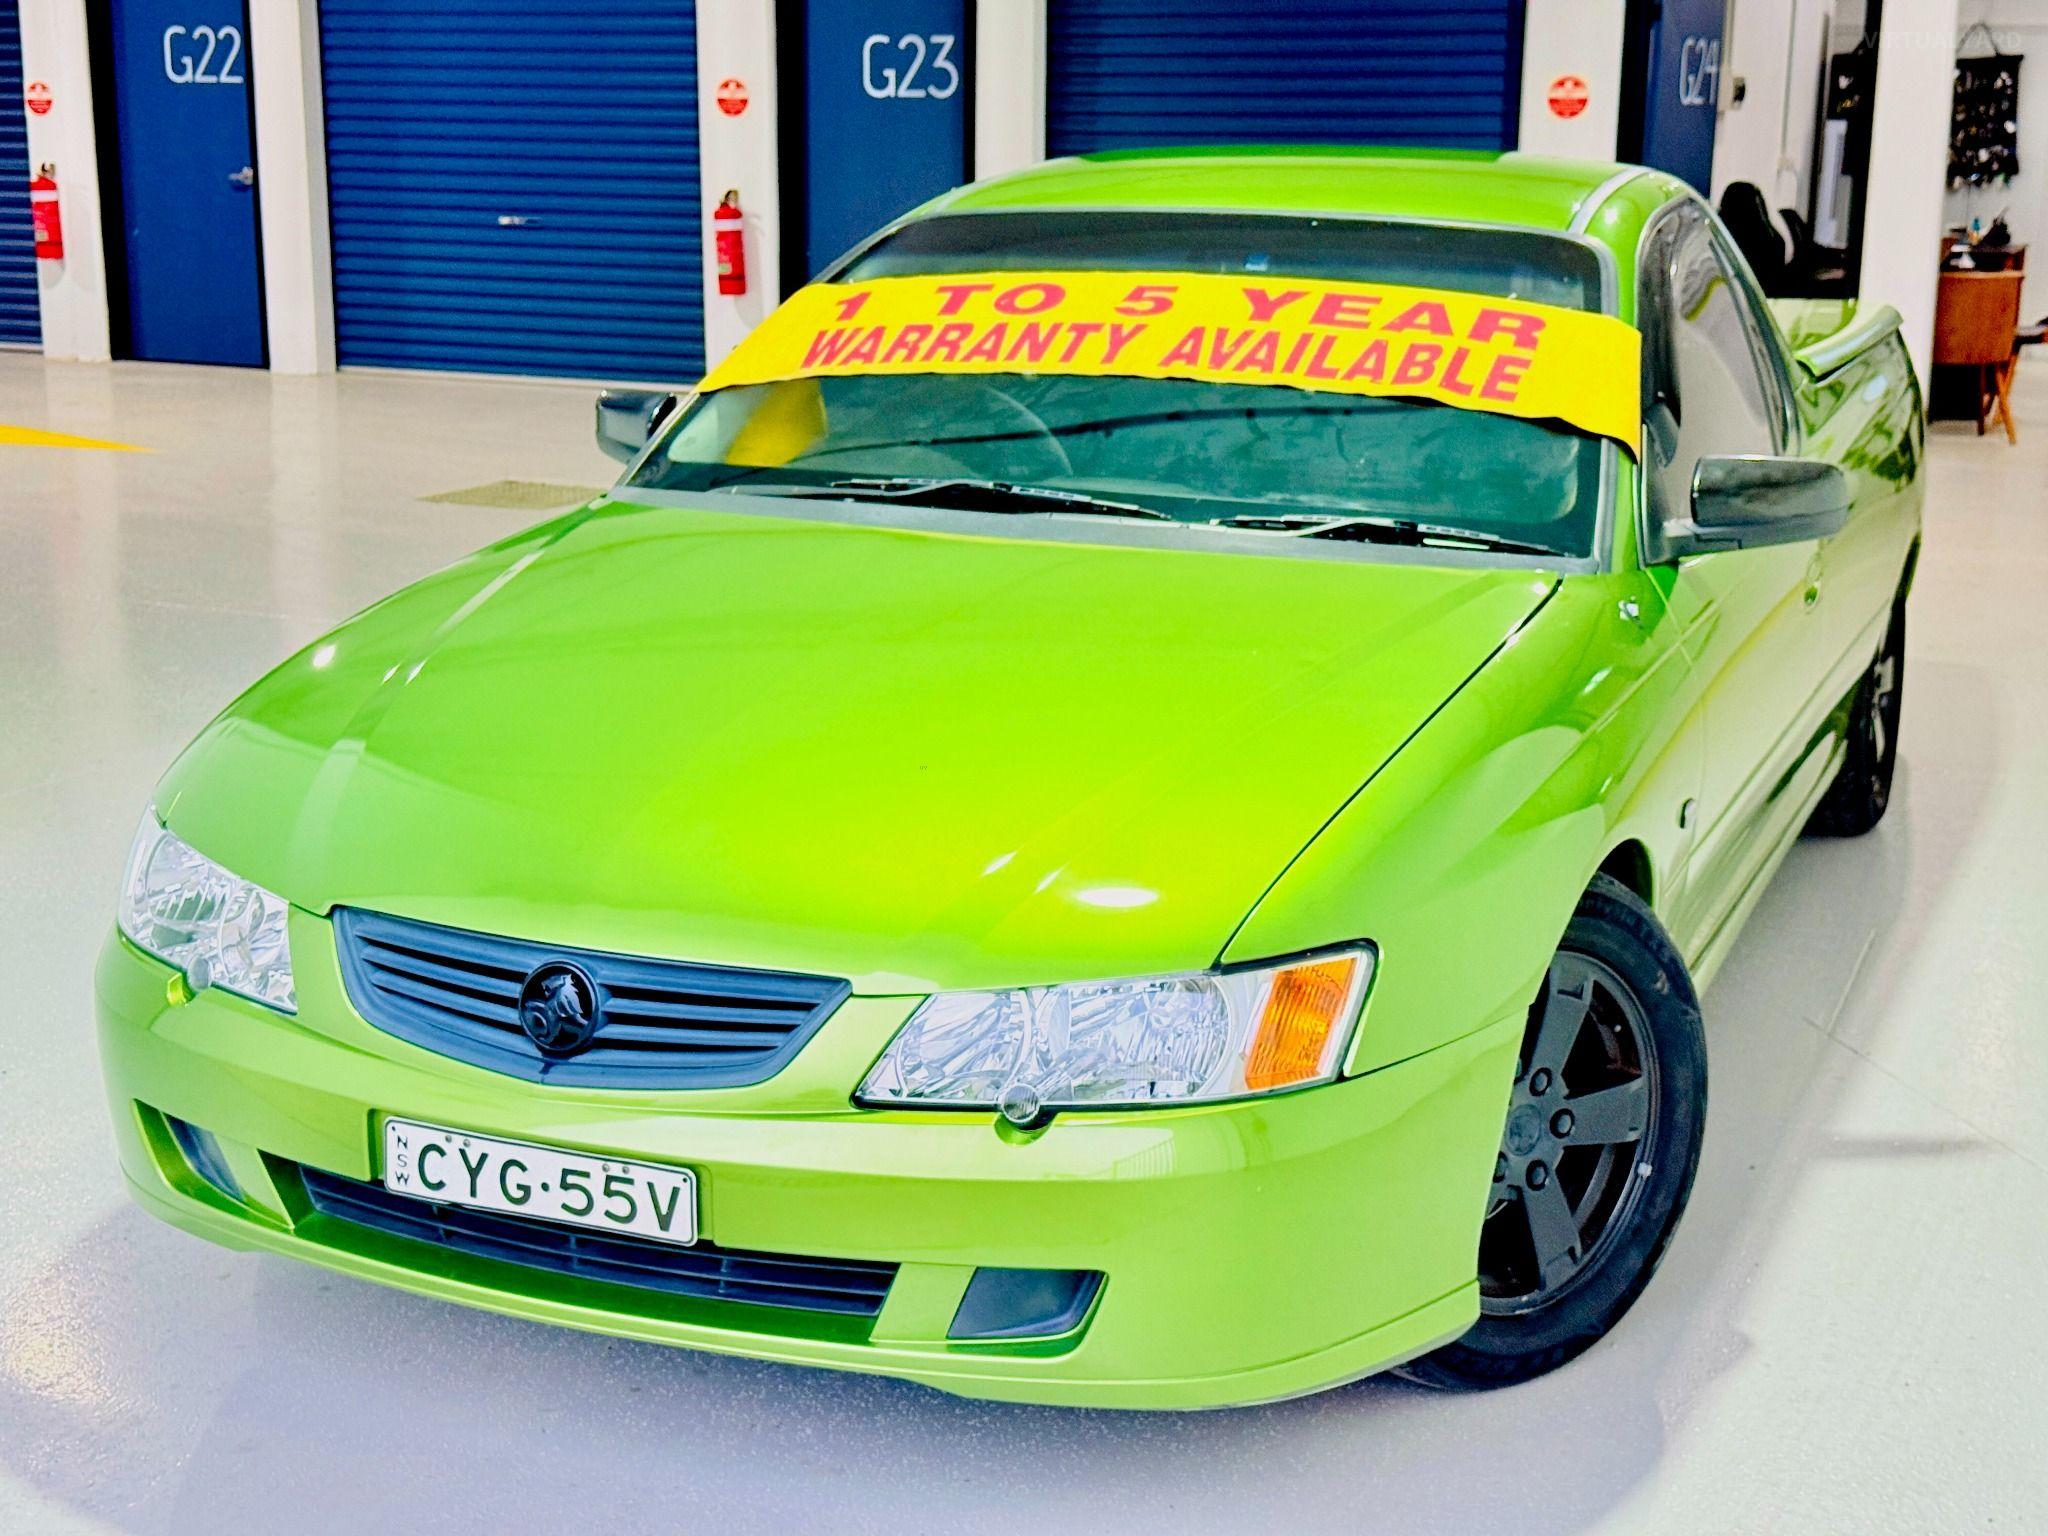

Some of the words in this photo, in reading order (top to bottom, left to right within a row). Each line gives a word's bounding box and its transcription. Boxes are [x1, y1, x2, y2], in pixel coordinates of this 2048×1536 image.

[163, 25, 243, 84] G22
[861, 34, 960, 99] G23
[1680, 37, 1720, 106] G24
[837, 292, 871, 321] 1
[937, 283, 1066, 316] TO
[1115, 285, 1177, 316] 5
[1242, 287, 1547, 350] YEAR
[801, 322, 1147, 368] WARRANTY
[1159, 326, 1532, 402] AVAILABLE
[395, 1135, 410, 1186] NSW
